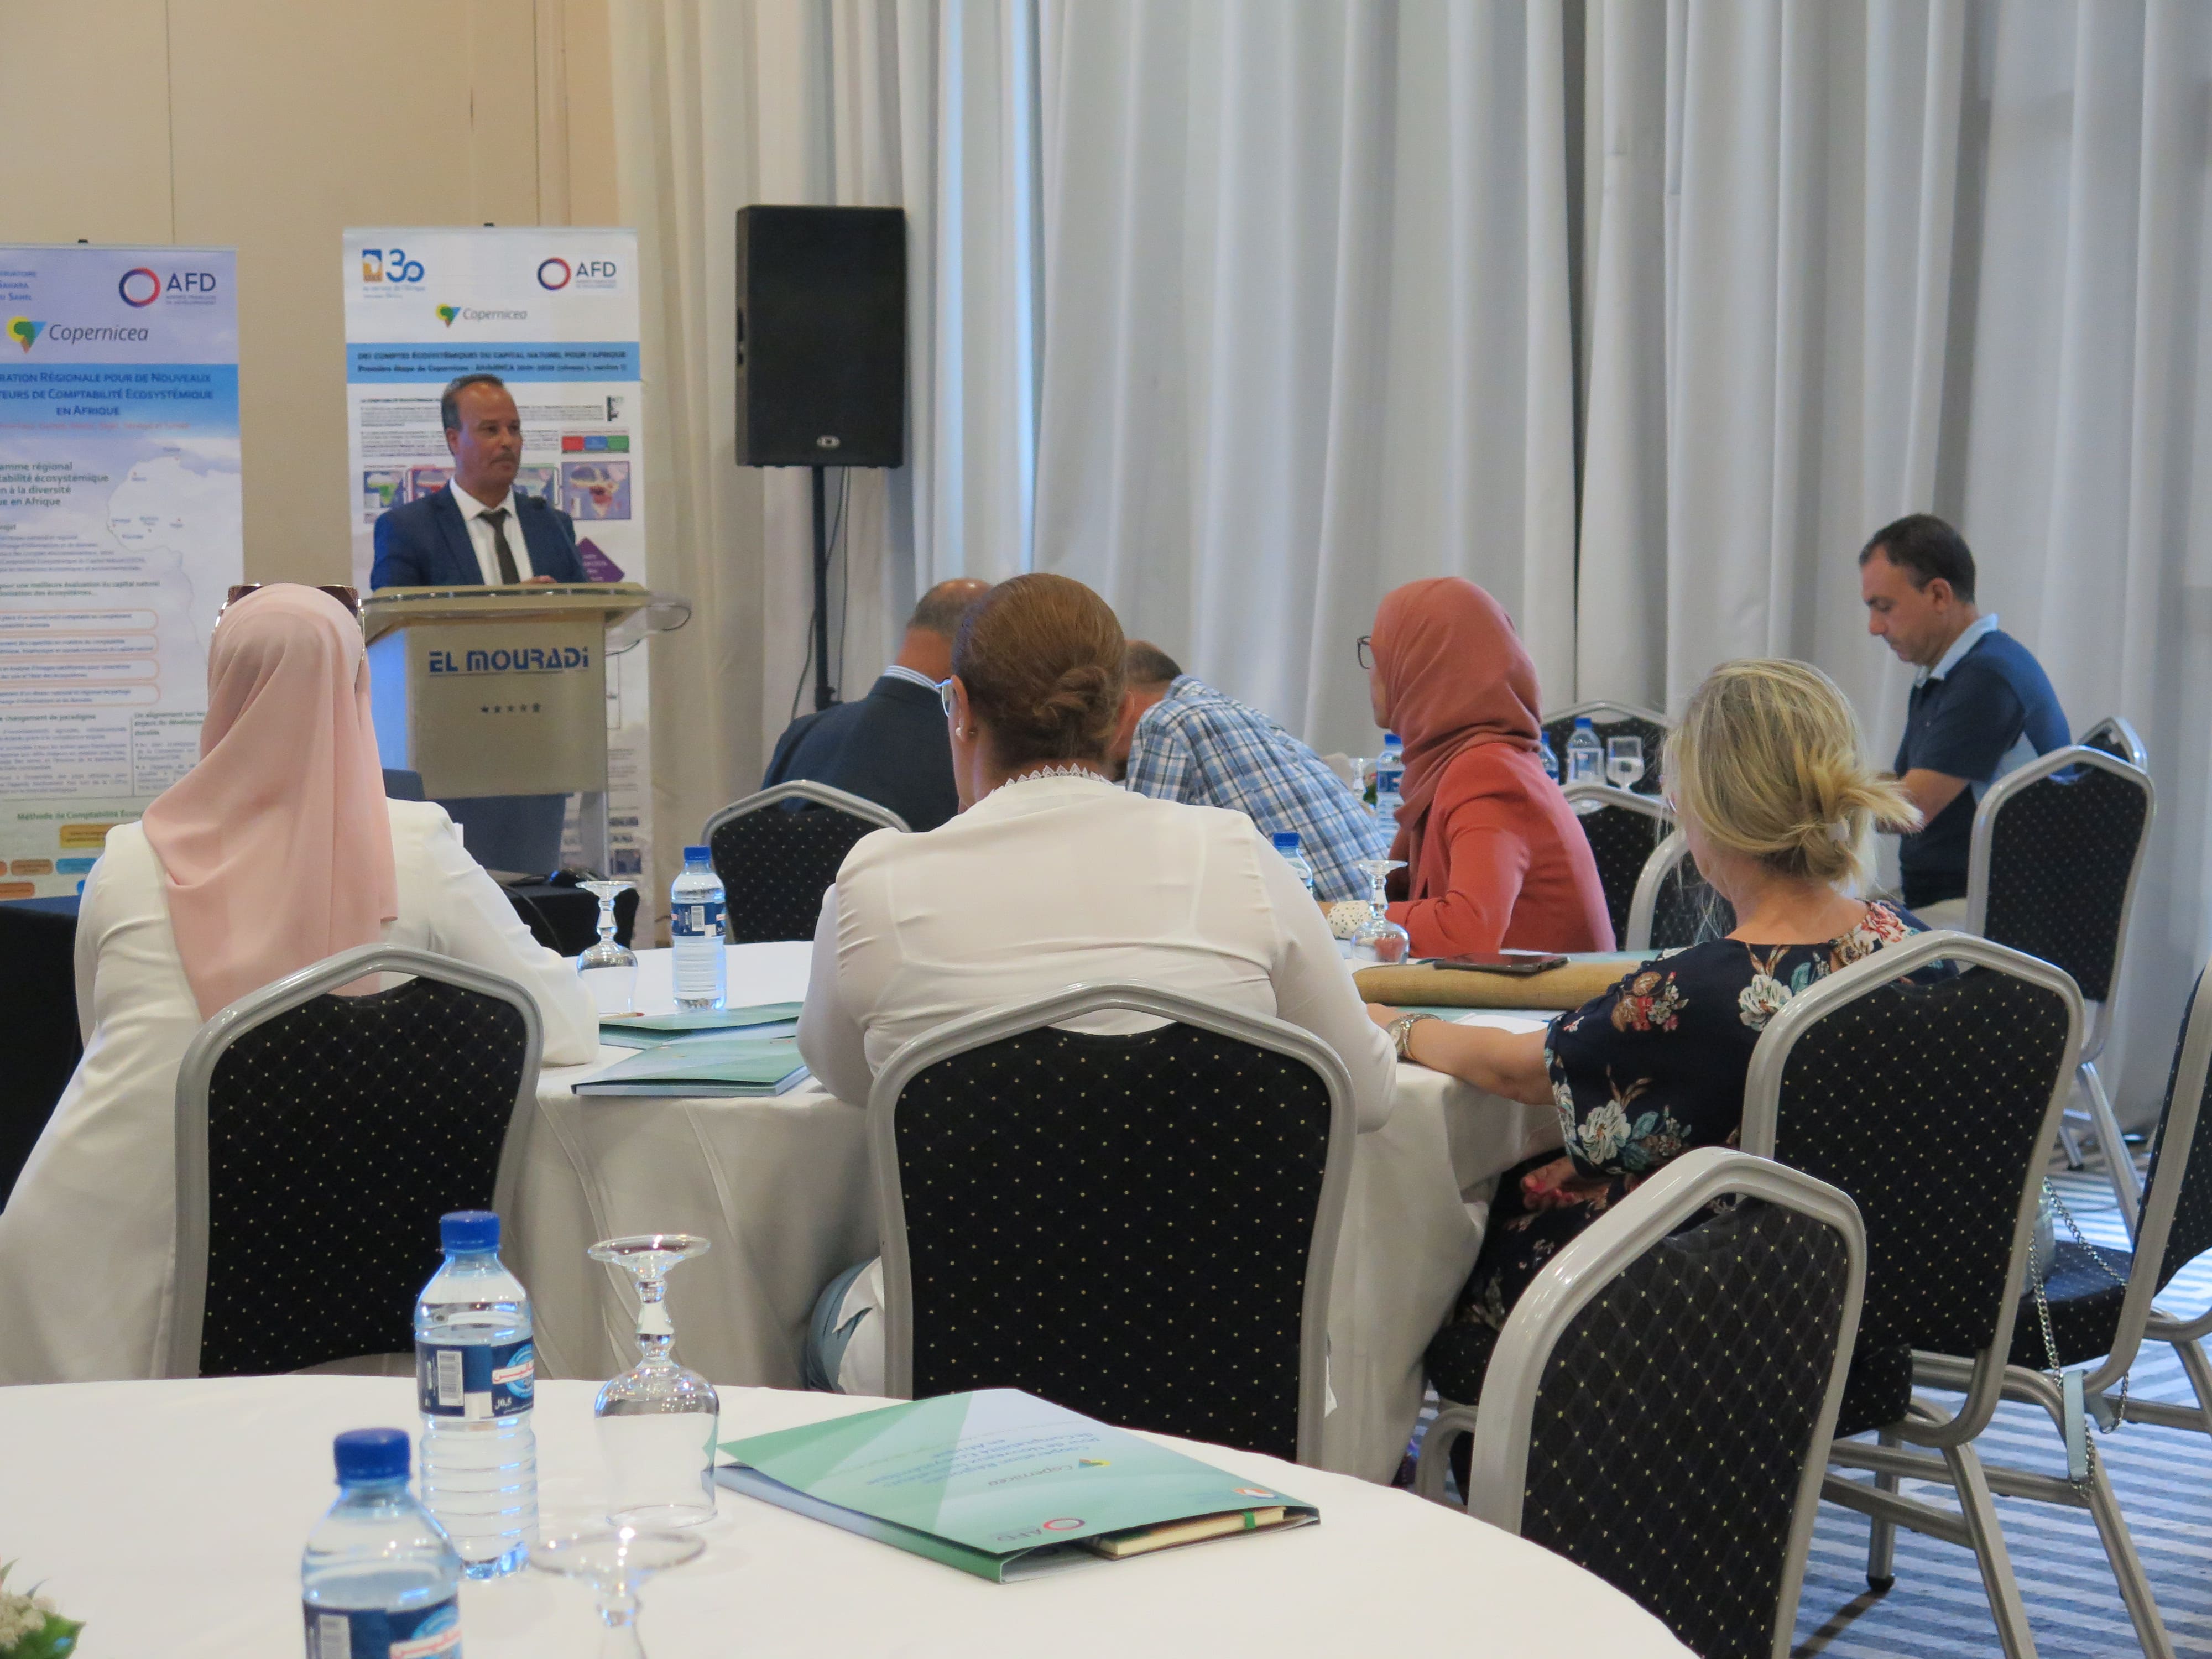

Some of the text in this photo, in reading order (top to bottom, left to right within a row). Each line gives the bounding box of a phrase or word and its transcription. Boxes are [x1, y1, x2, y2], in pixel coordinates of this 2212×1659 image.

[576, 262, 616, 278] AFD
[166, 272, 216, 292] AFD
[463, 307, 528, 322] Copernicea
[49, 324, 149, 345] Copernicea
[429, 650, 458, 673] EL
